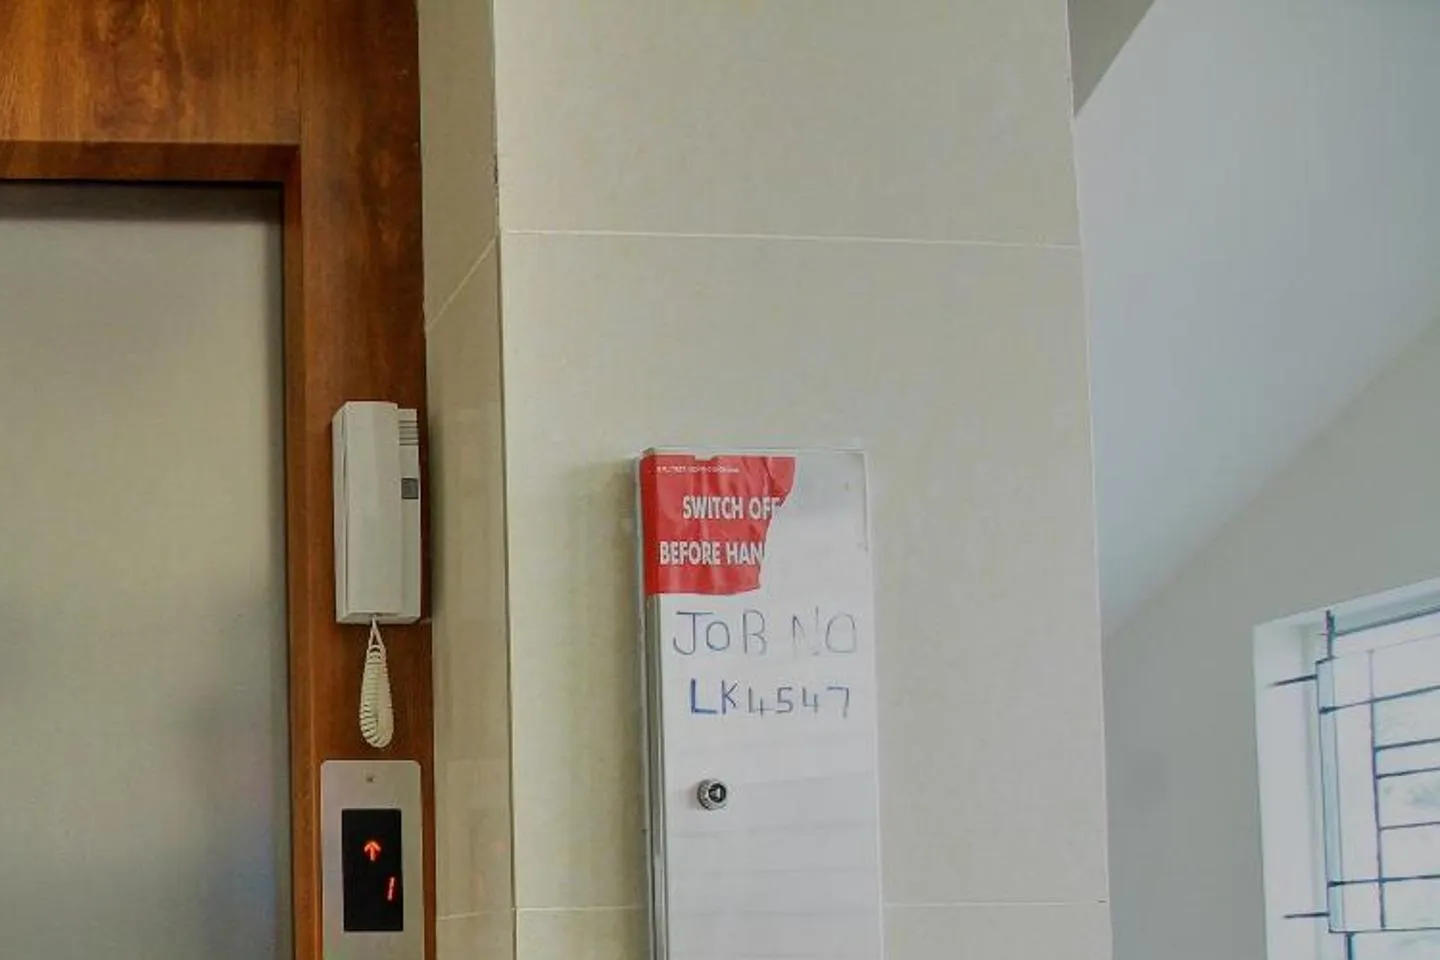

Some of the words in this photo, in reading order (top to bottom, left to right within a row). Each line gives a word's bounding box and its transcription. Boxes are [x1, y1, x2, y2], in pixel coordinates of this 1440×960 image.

[682, 495, 744, 519] SWITCH
[659, 541, 721, 565] BEFORE
[690, 678, 851, 718] LK4547
[387, 876, 396, 901] 1
